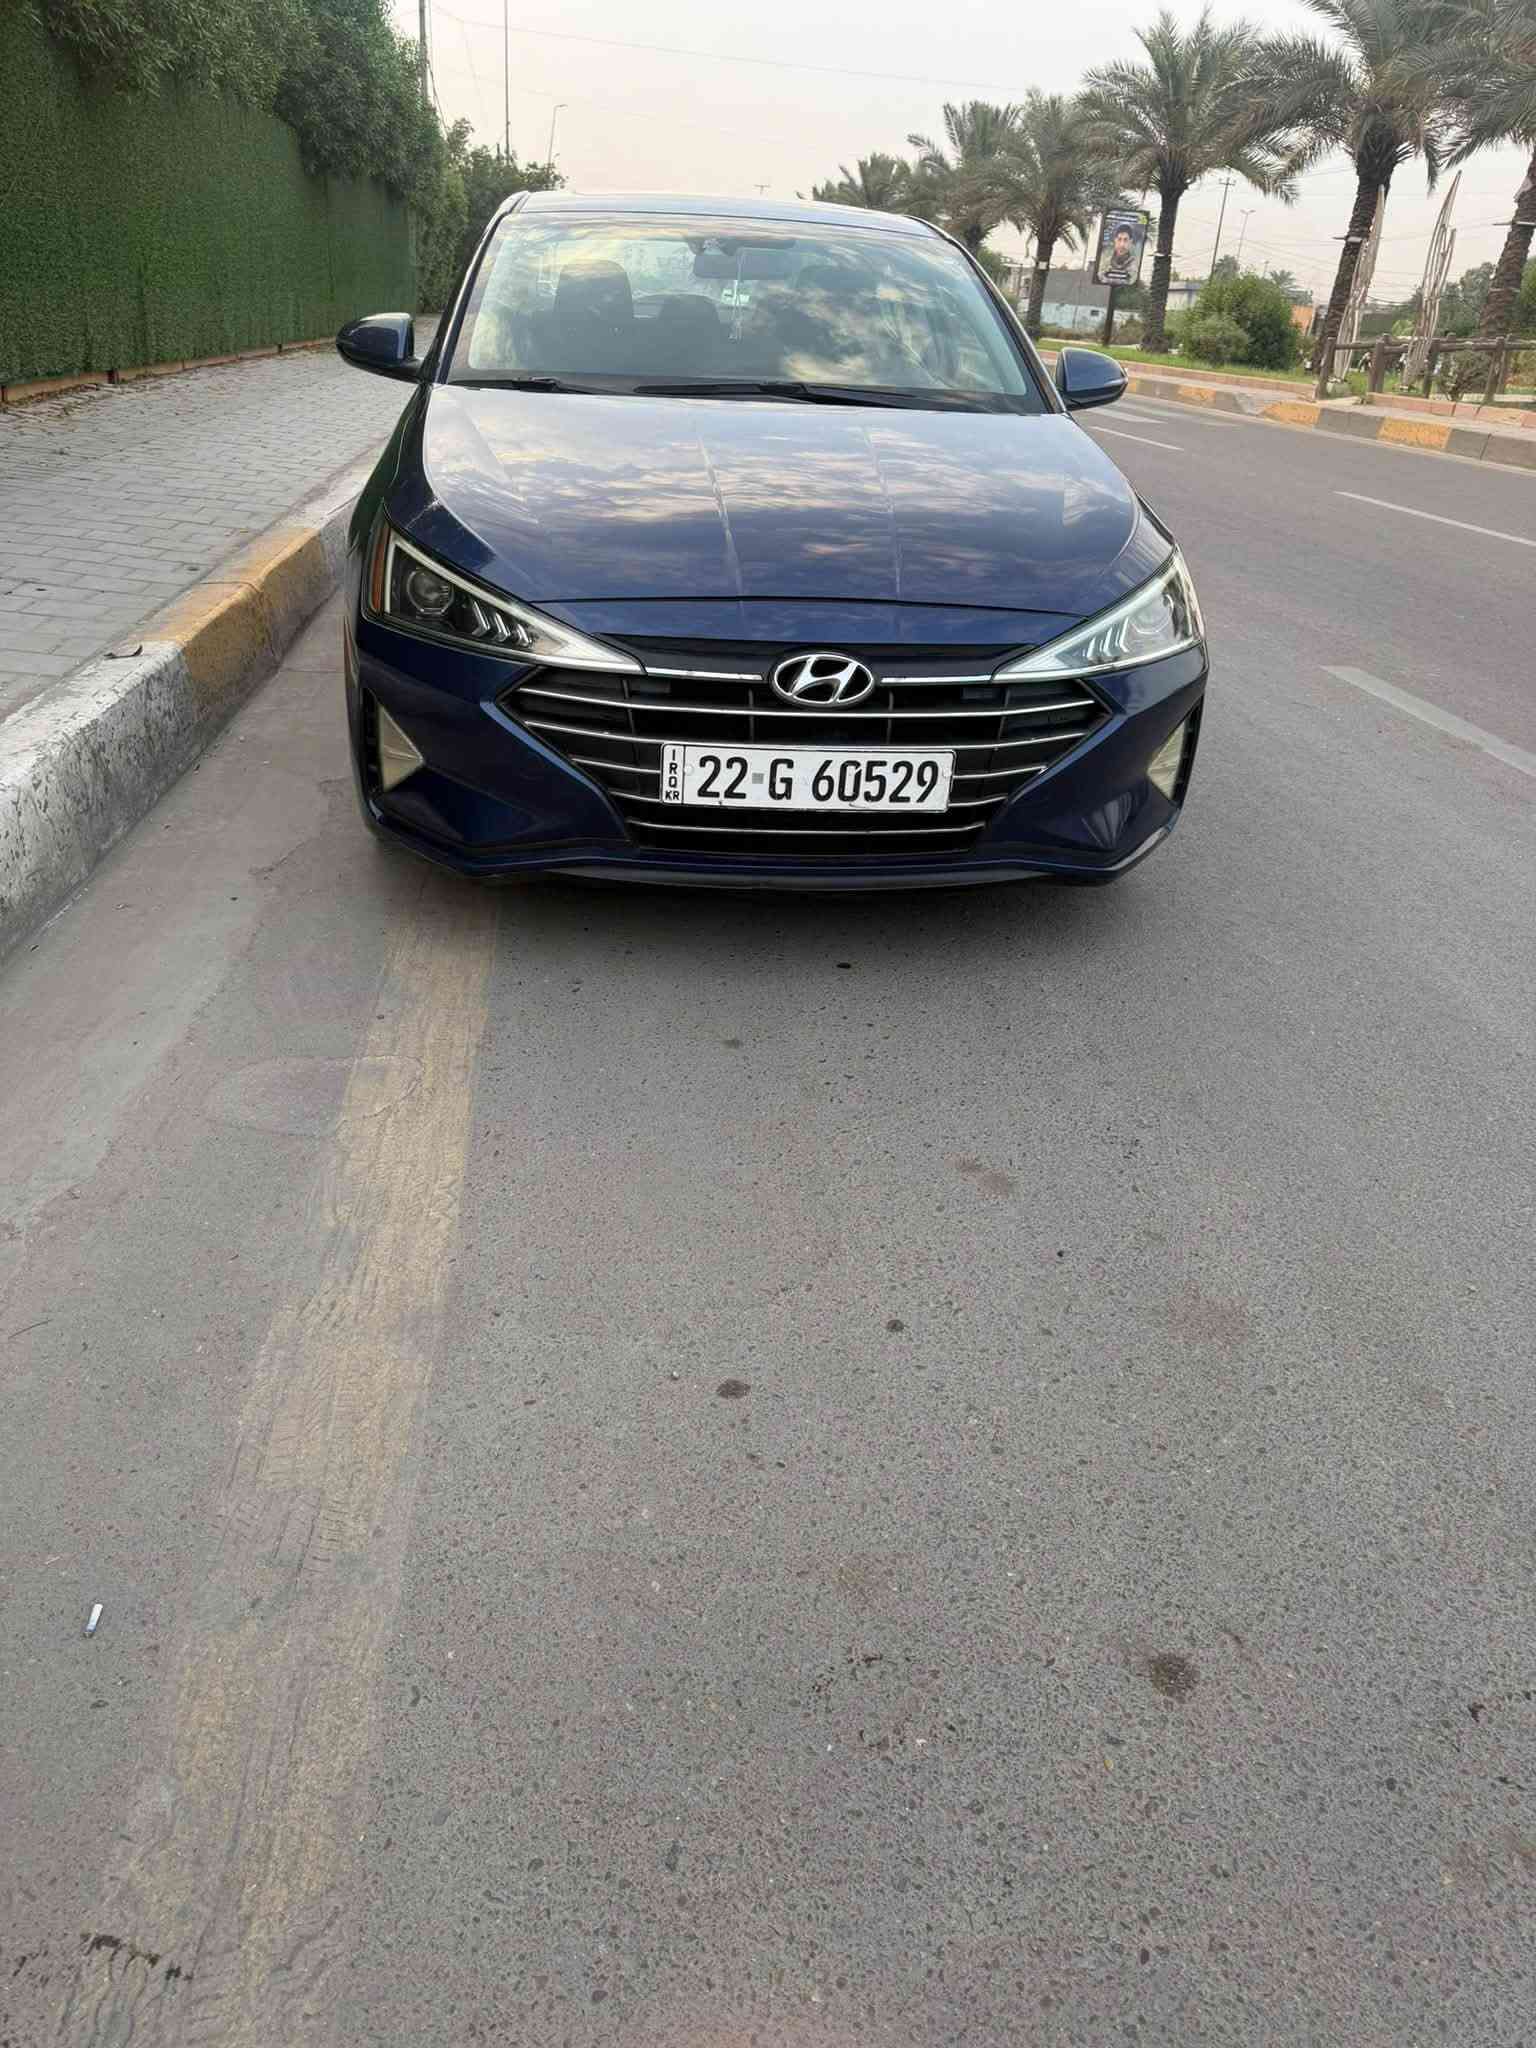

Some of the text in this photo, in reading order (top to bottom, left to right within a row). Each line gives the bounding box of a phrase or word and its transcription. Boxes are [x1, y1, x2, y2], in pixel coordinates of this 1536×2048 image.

[697, 755, 939, 804] 22 G 60529
[665, 790, 680, 801] KR
